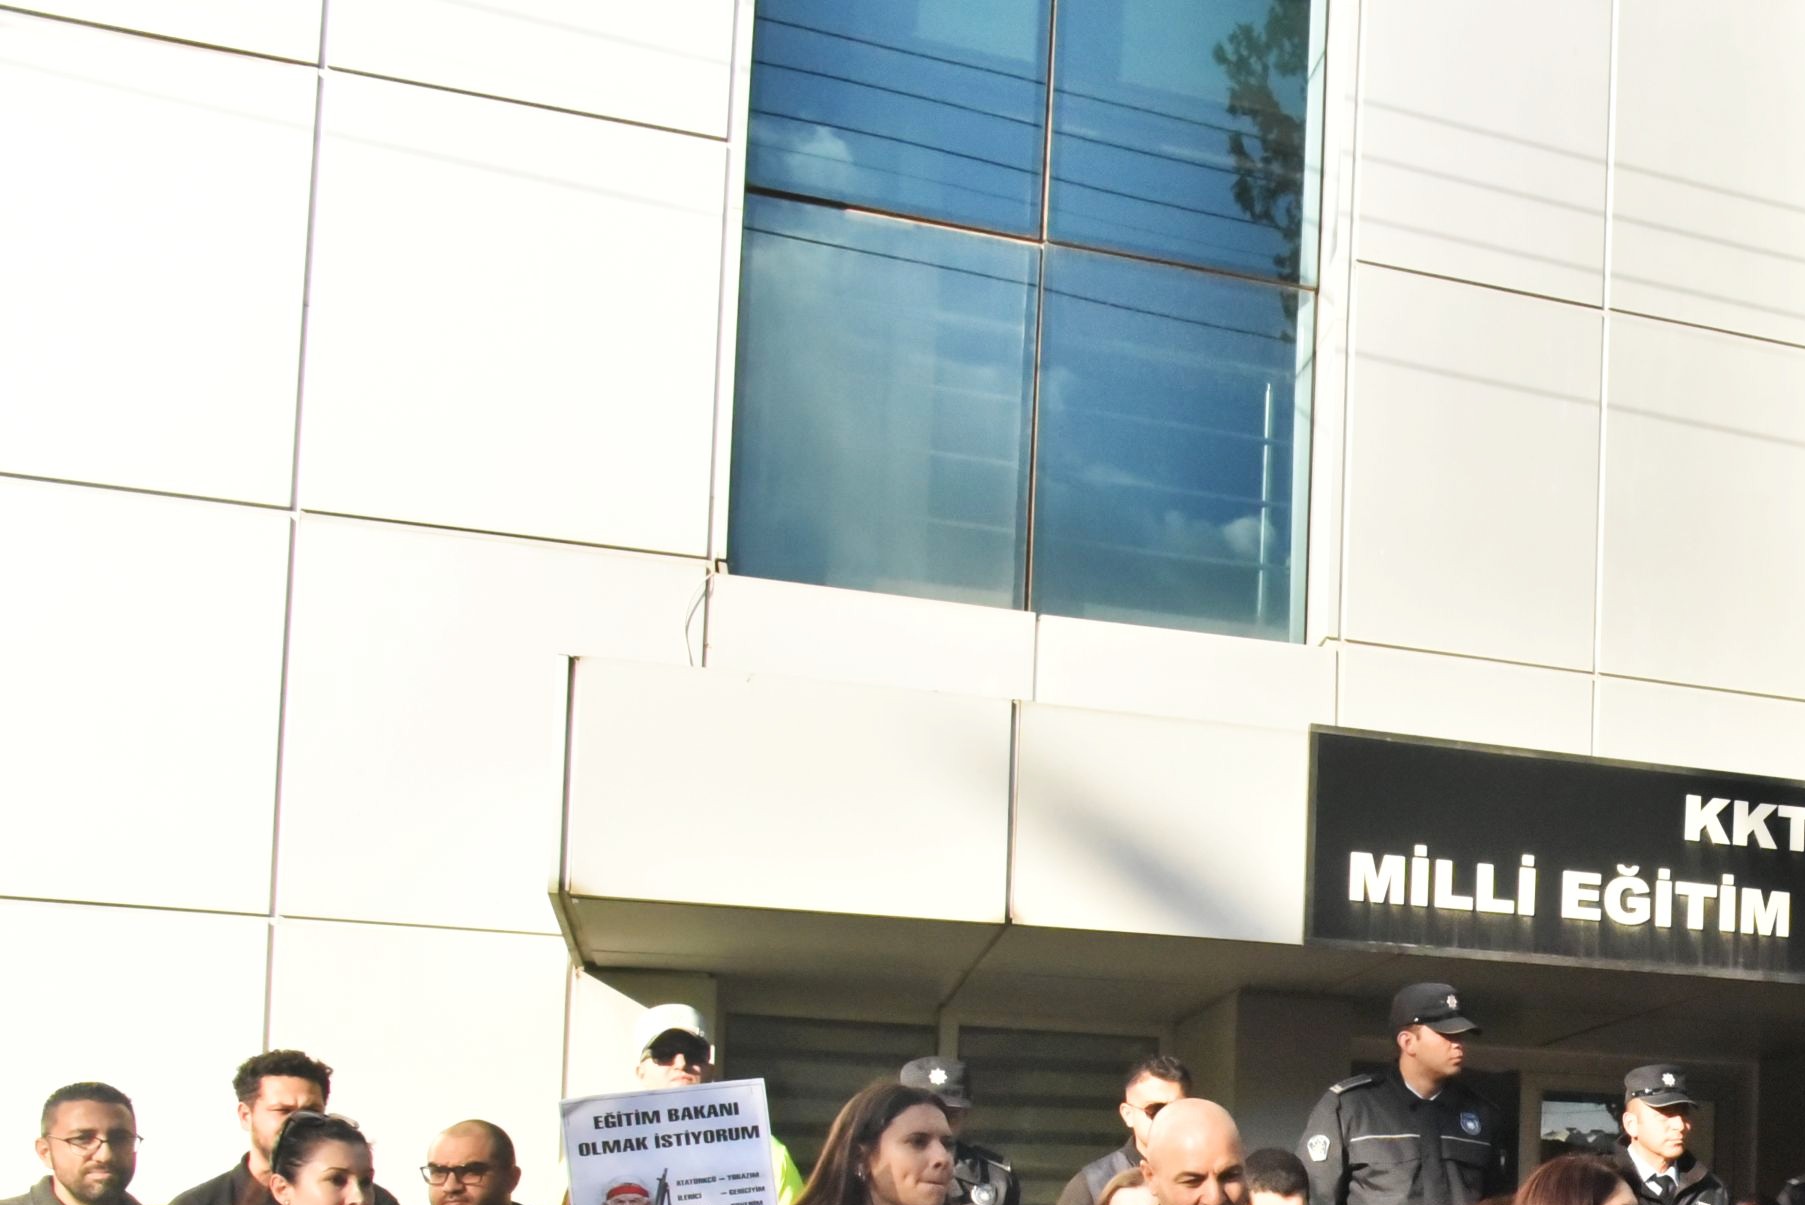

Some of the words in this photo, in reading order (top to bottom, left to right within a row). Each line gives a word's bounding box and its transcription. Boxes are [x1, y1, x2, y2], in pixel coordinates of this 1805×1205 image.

[1349, 845, 1536, 916] MİLLİ
[1561, 864, 1790, 937] EĞİTİM
[593, 1109, 661, 1130] EĞİTİM
[667, 1101, 740, 1123] BAKANI
[578, 1136, 649, 1157] OLMAK
[655, 1124, 760, 1149] İSTİYORUM
